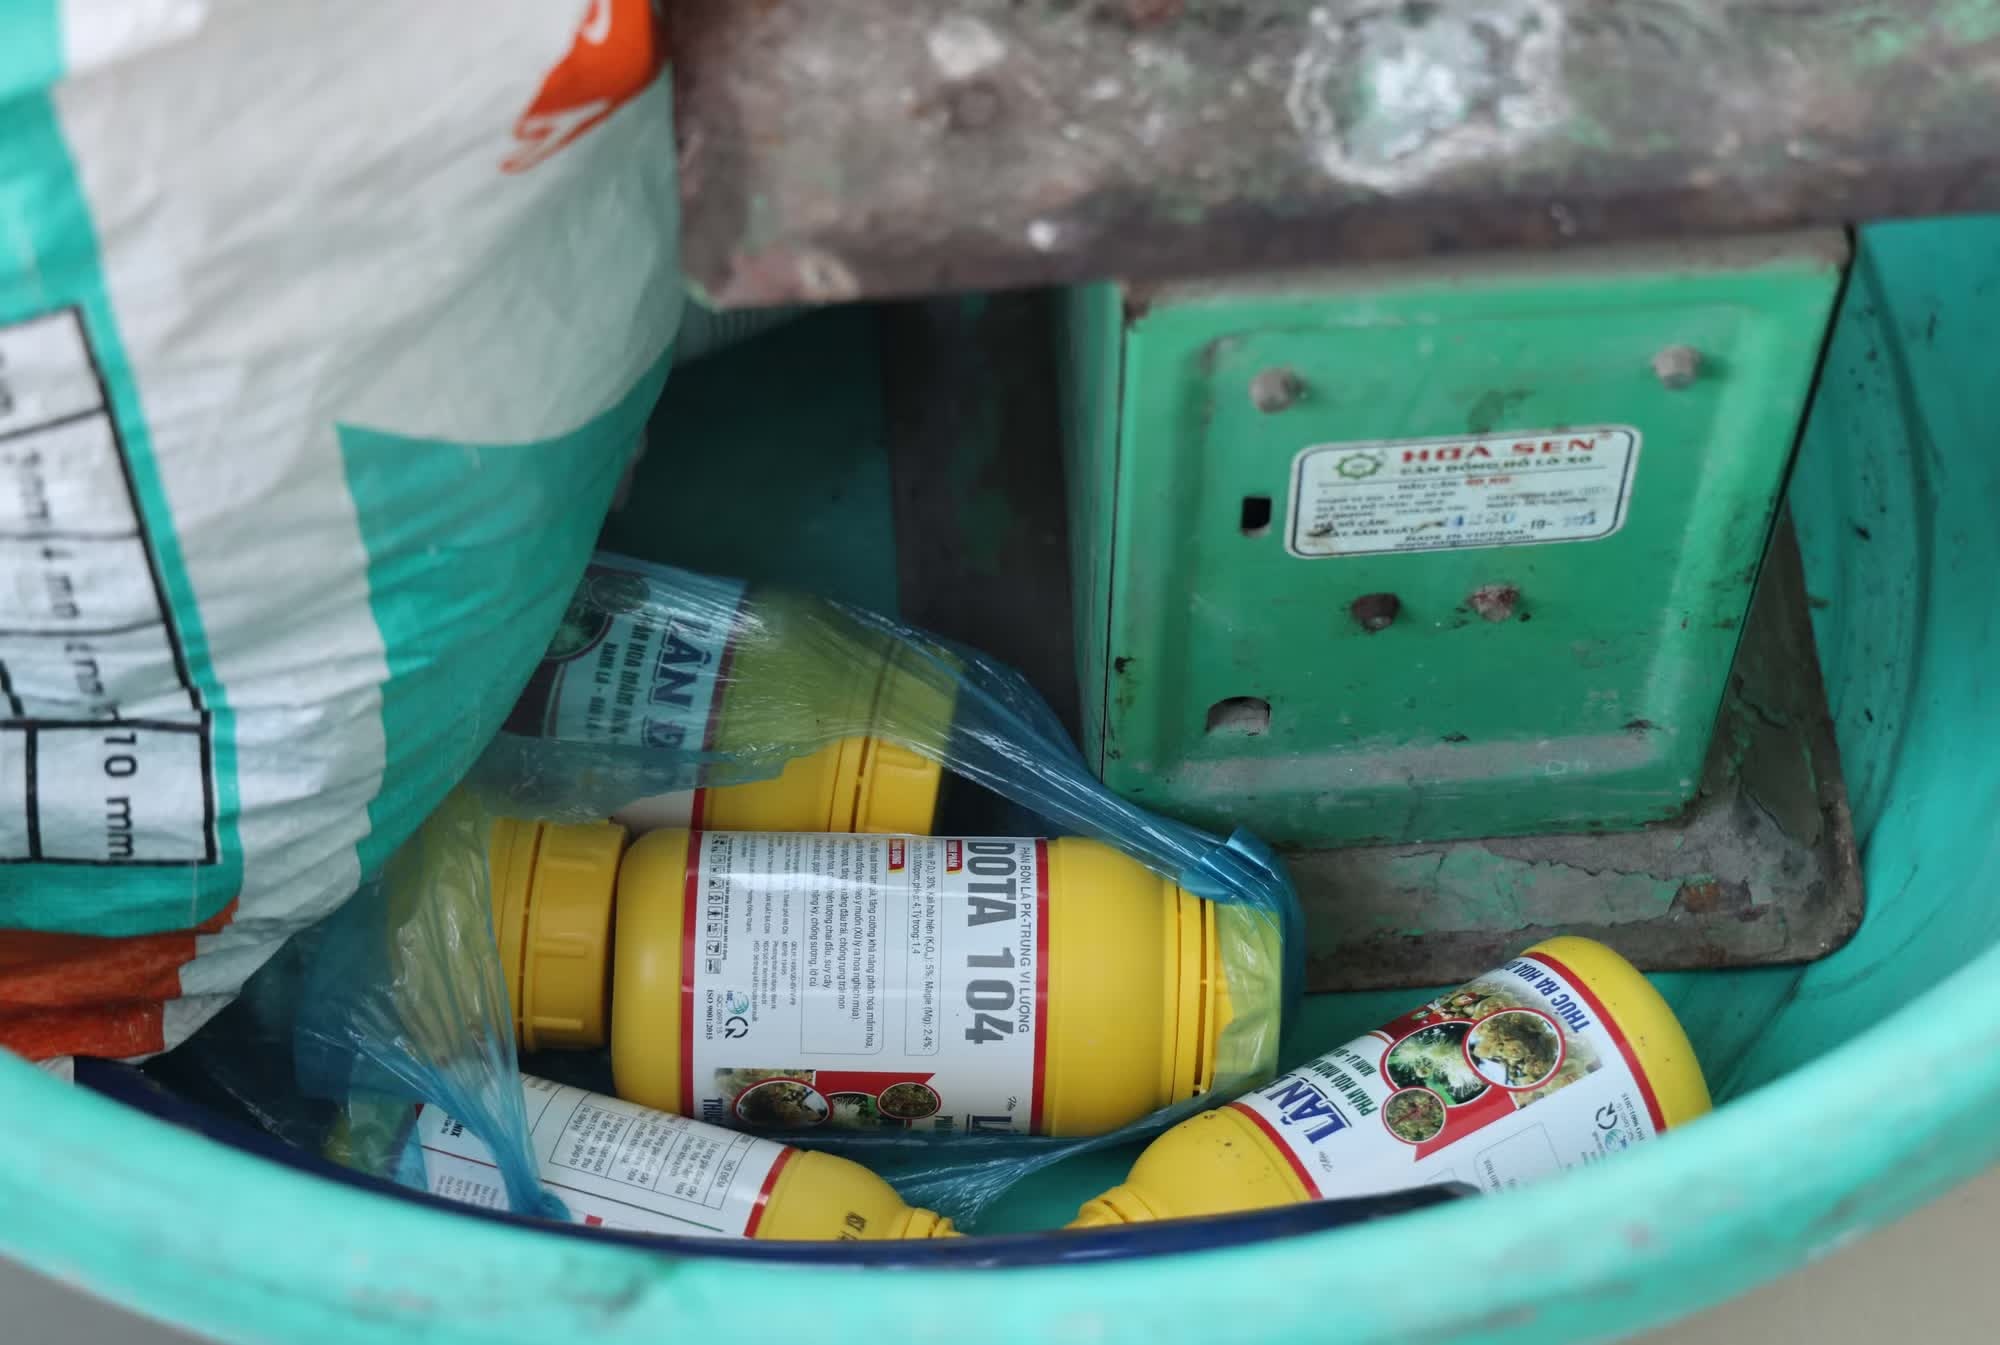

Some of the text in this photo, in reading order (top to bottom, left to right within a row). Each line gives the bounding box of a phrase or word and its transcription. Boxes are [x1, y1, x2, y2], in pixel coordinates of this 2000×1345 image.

[1511, 438, 1596, 455] SEN
[103, 731, 138, 861] 10 mm
[965, 842, 1017, 1045] DOTA 104
[1020, 903, 1033, 968] PK-TRUNG
[1513, 963, 1545, 982] HOA
[1534, 977, 1561, 997] RA
[1016, 988, 1031, 1033] LƯỢNG
[1551, 994, 1590, 1033] THÚC
[1264, 1078, 1352, 1145] LÂN
[1345, 1088, 1379, 1117] PHÂN
